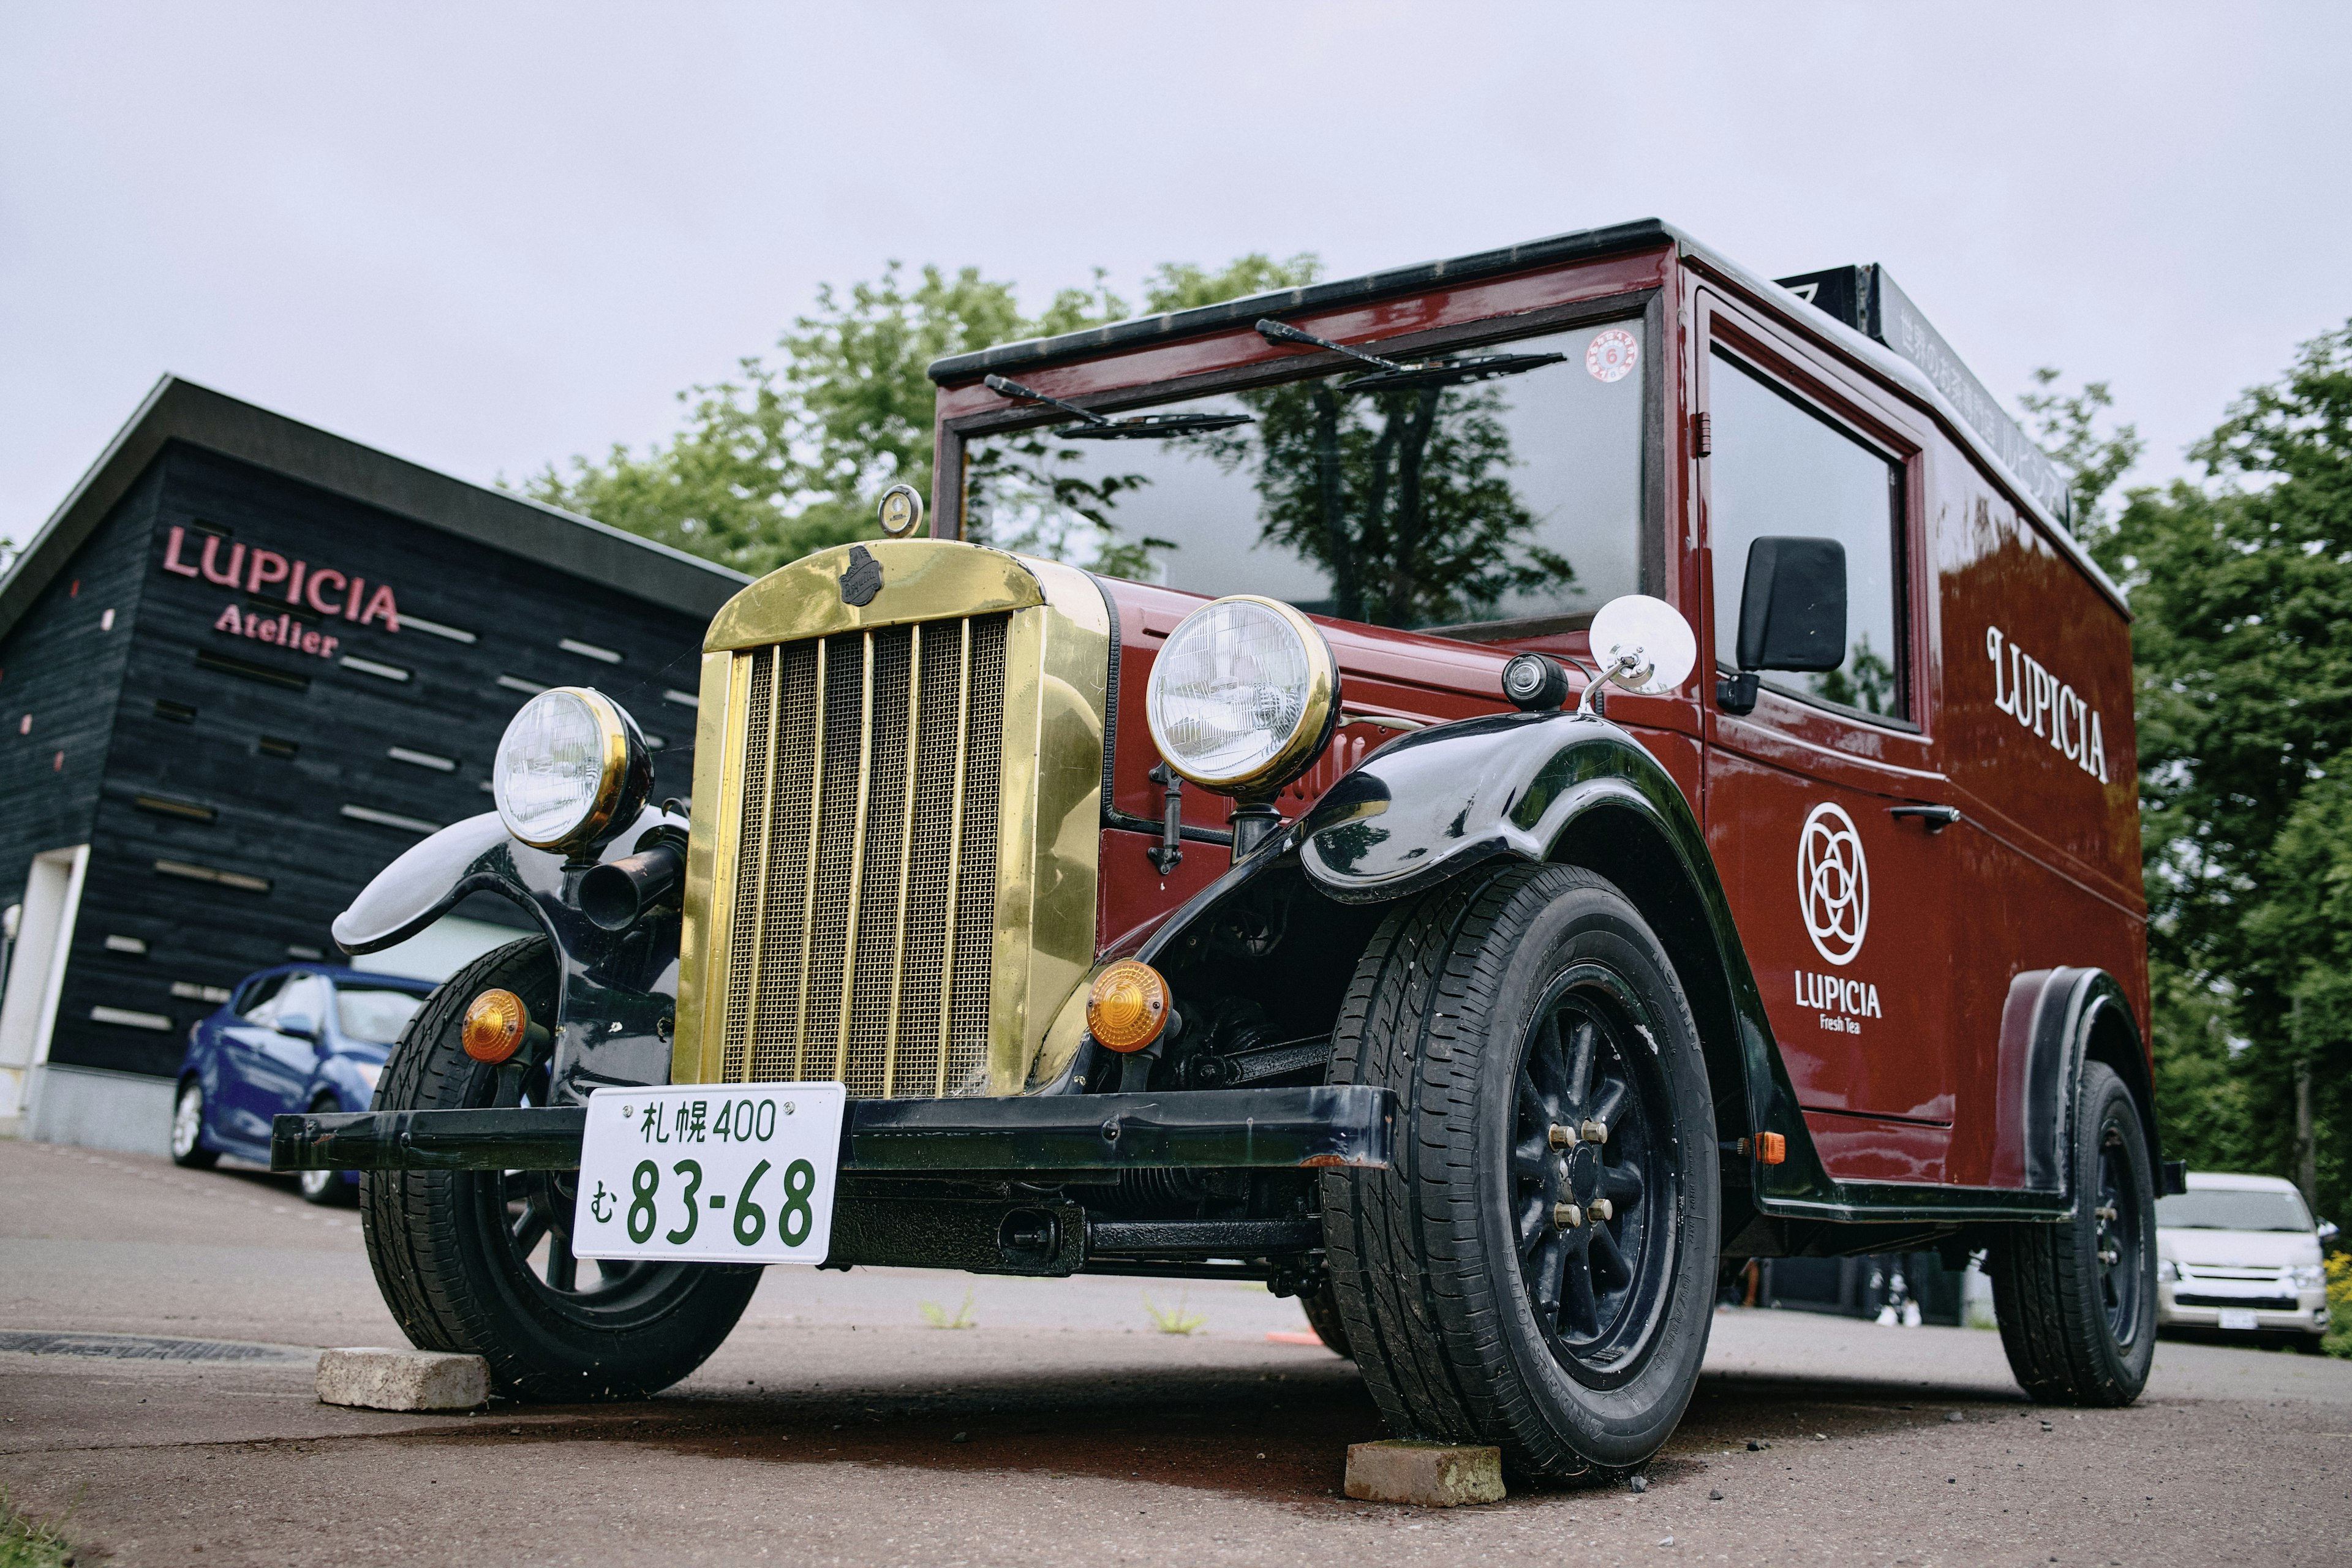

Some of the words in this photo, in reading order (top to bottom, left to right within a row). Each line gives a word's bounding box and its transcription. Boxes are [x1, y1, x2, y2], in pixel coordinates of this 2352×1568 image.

[1607, 348, 1618, 364] 6
[163, 526, 401, 633] LUPICIA
[214, 603, 339, 658] Atelier
[1986, 625, 2109, 785] LUPICIA
[1652, 951, 1702, 1054] NEXTRY
[1795, 970, 1882, 1019] LUPICIA
[1820, 1013, 1844, 1033] Fresh
[1845, 1017, 1861, 1035] Tea
[591, 1180, 618, 1224] む
[627, 1158, 816, 1248] 83-68
[1502, 1250, 1605, 1444] BRIDGESTONE
[1629, 1378, 1649, 1396] TUBELESS
